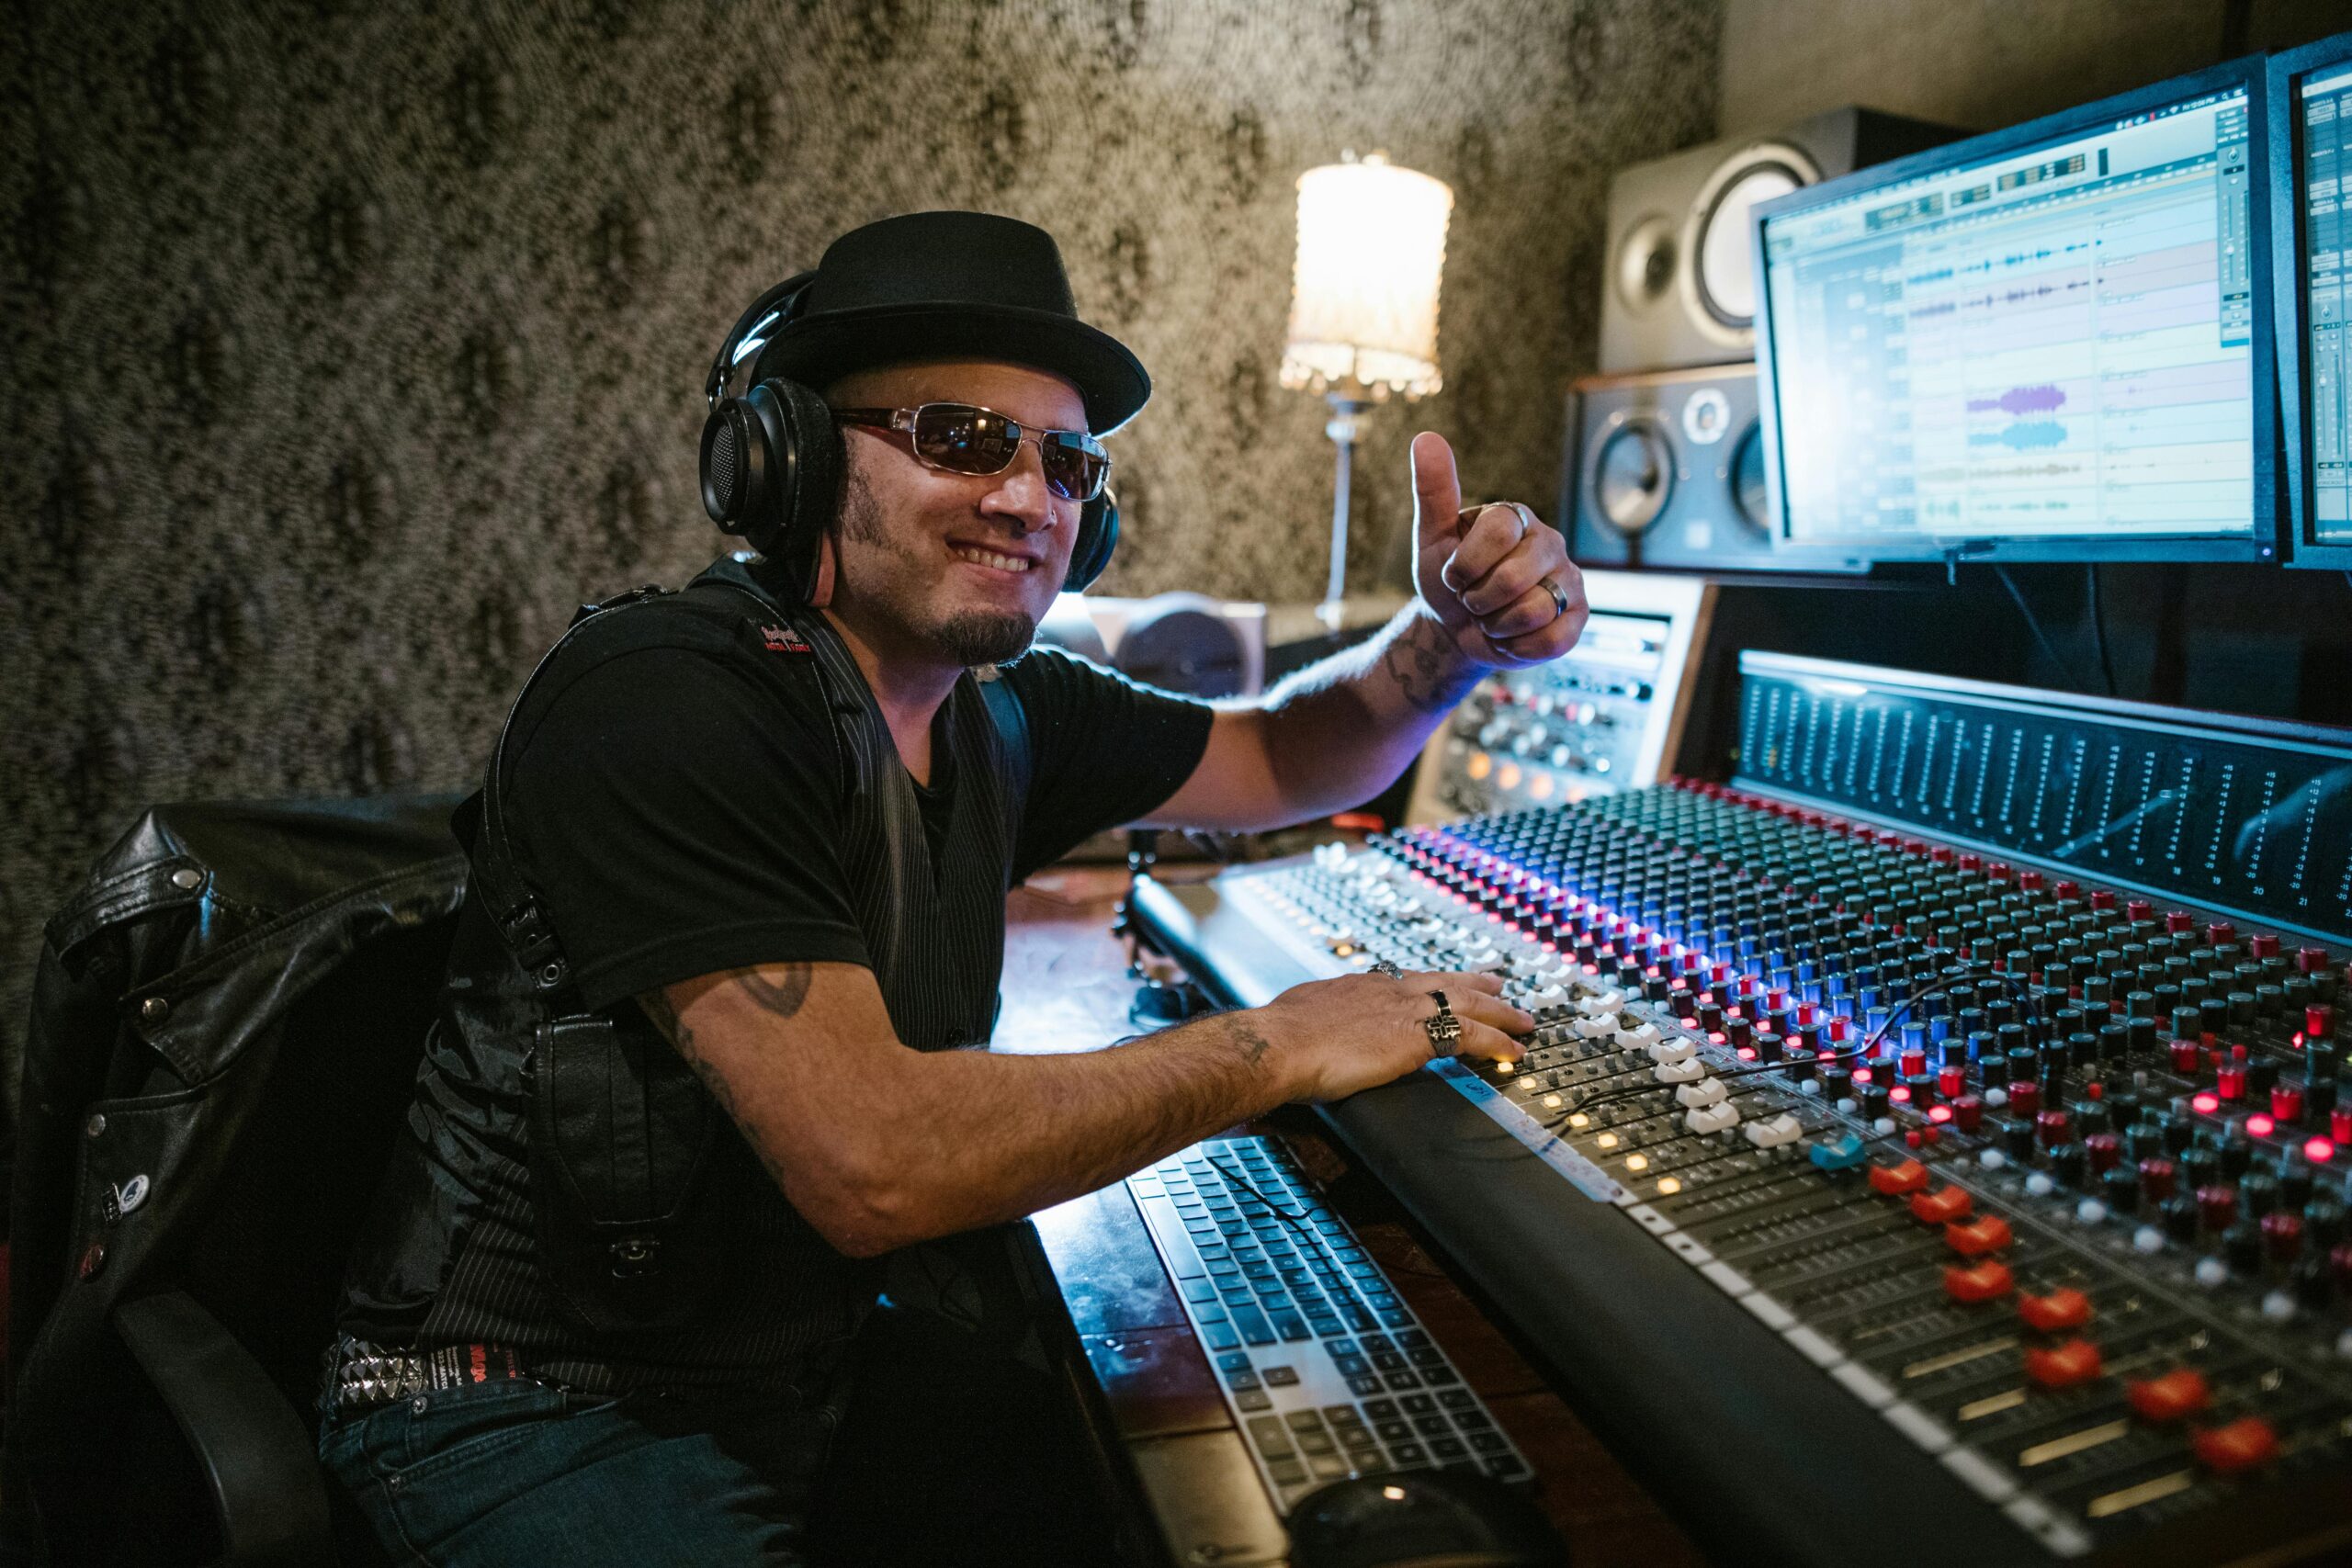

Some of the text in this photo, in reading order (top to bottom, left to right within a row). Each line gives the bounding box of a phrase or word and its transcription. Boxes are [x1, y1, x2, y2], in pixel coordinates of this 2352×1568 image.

[2213, 876, 2221, 885] 19
[2253, 886, 2264, 895] 20
[2299, 897, 2308, 906] 21
